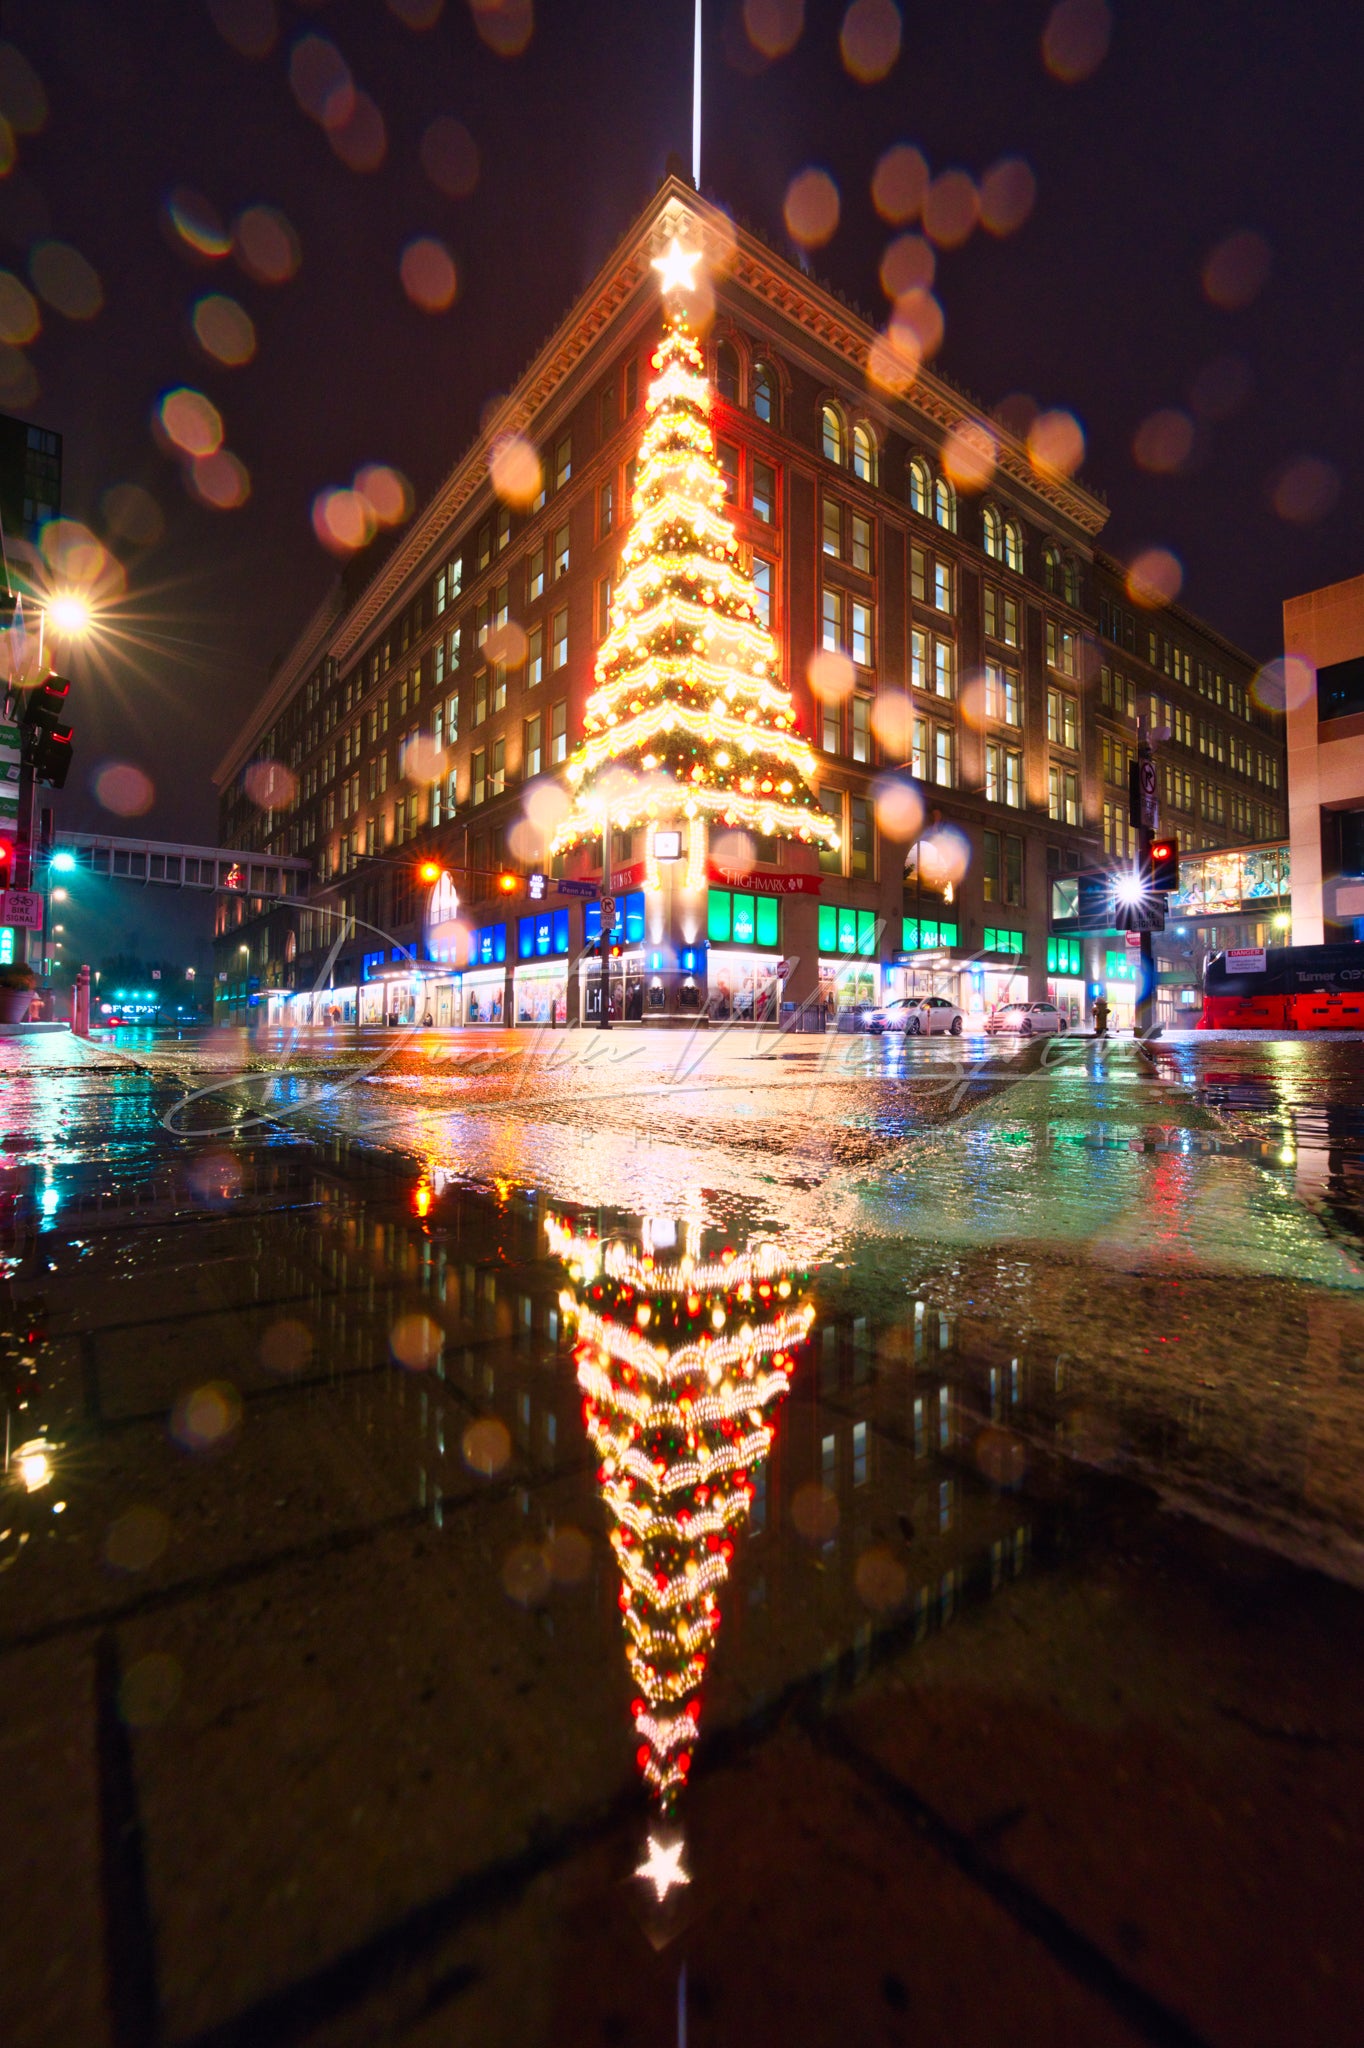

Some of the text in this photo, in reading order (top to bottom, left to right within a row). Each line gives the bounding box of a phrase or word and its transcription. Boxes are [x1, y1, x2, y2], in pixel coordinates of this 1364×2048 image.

[531, 874, 543, 882] NO
[719, 868, 786, 892] HIGHMARK
[562, 886, 592, 897] Penn Ave
[11, 906, 30, 914] BIKE
[6, 914, 34, 923] SIGNAL
[734, 922, 752, 933] AHN
[840, 934, 854, 944] AHN
[923, 932, 947, 946] AHN
[1231, 949, 1260, 957] DANGER
[1296, 971, 1336, 982] Turner
